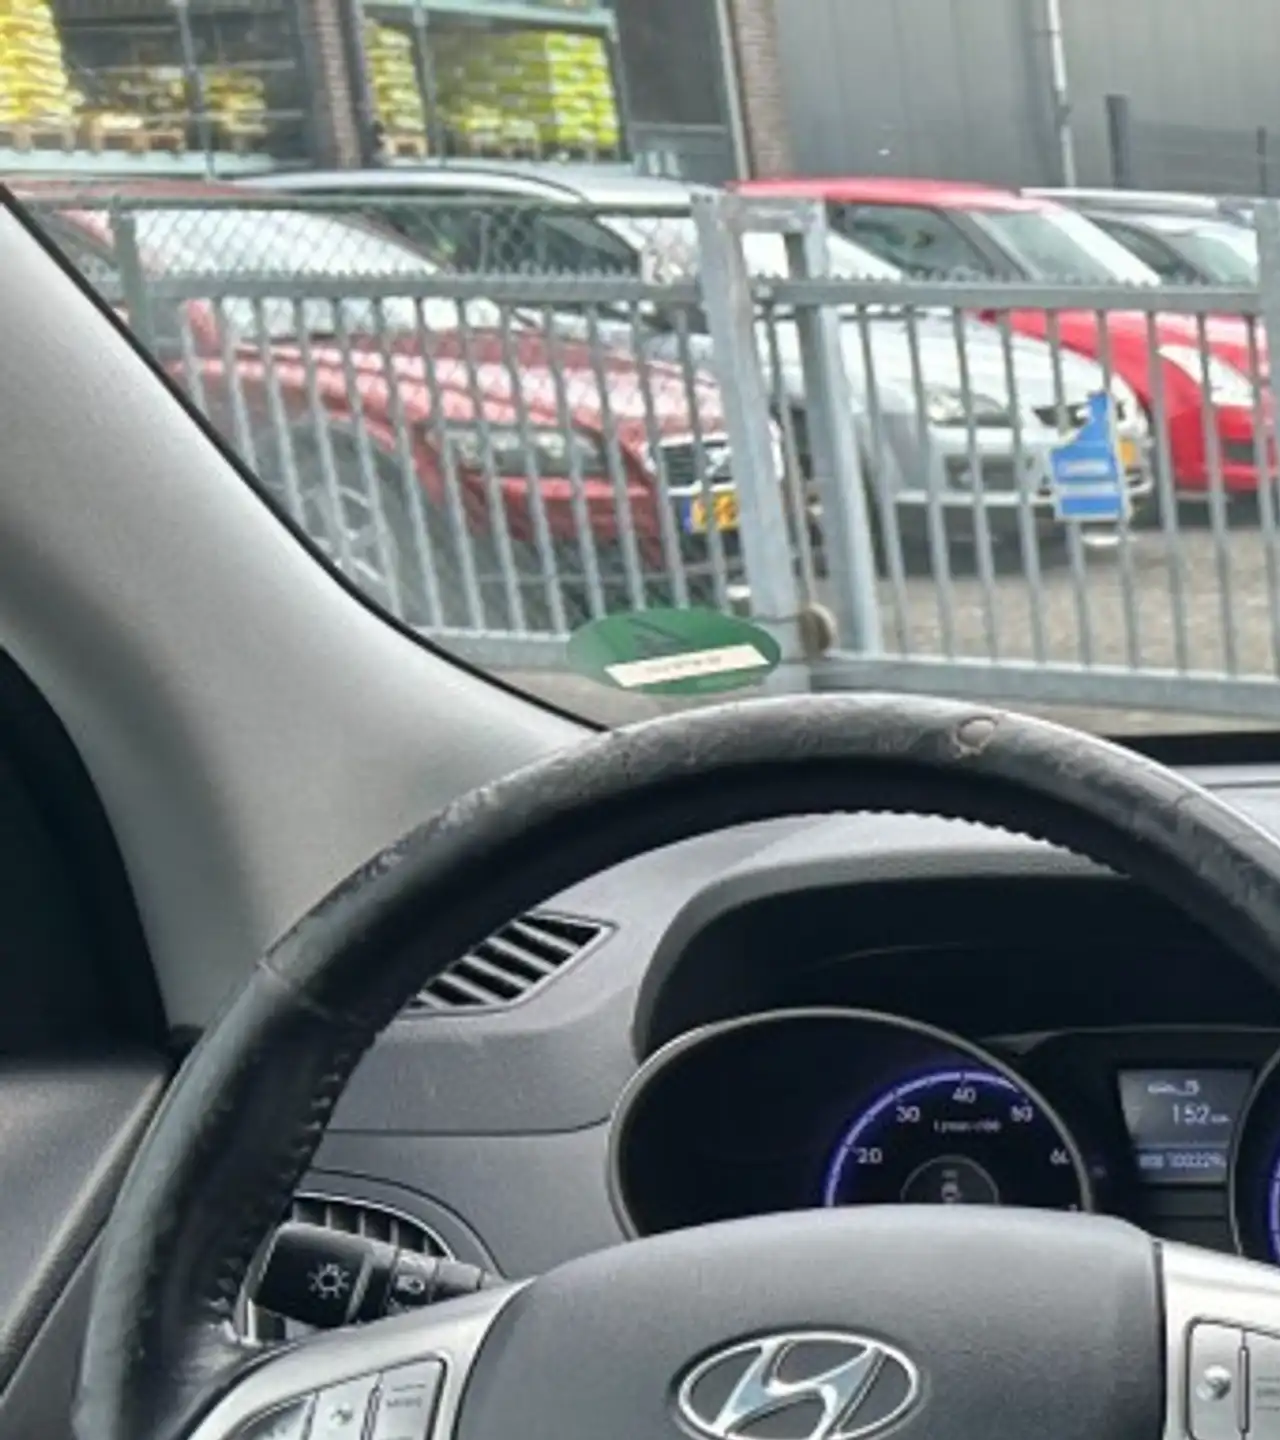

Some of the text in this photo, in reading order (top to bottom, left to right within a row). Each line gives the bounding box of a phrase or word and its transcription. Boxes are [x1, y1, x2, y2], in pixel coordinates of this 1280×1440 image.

[952, 1087, 976, 1103] 40
[896, 1106, 921, 1122] 30
[1173, 1103, 1210, 1125] 152
[857, 1147, 883, 1164] 20
